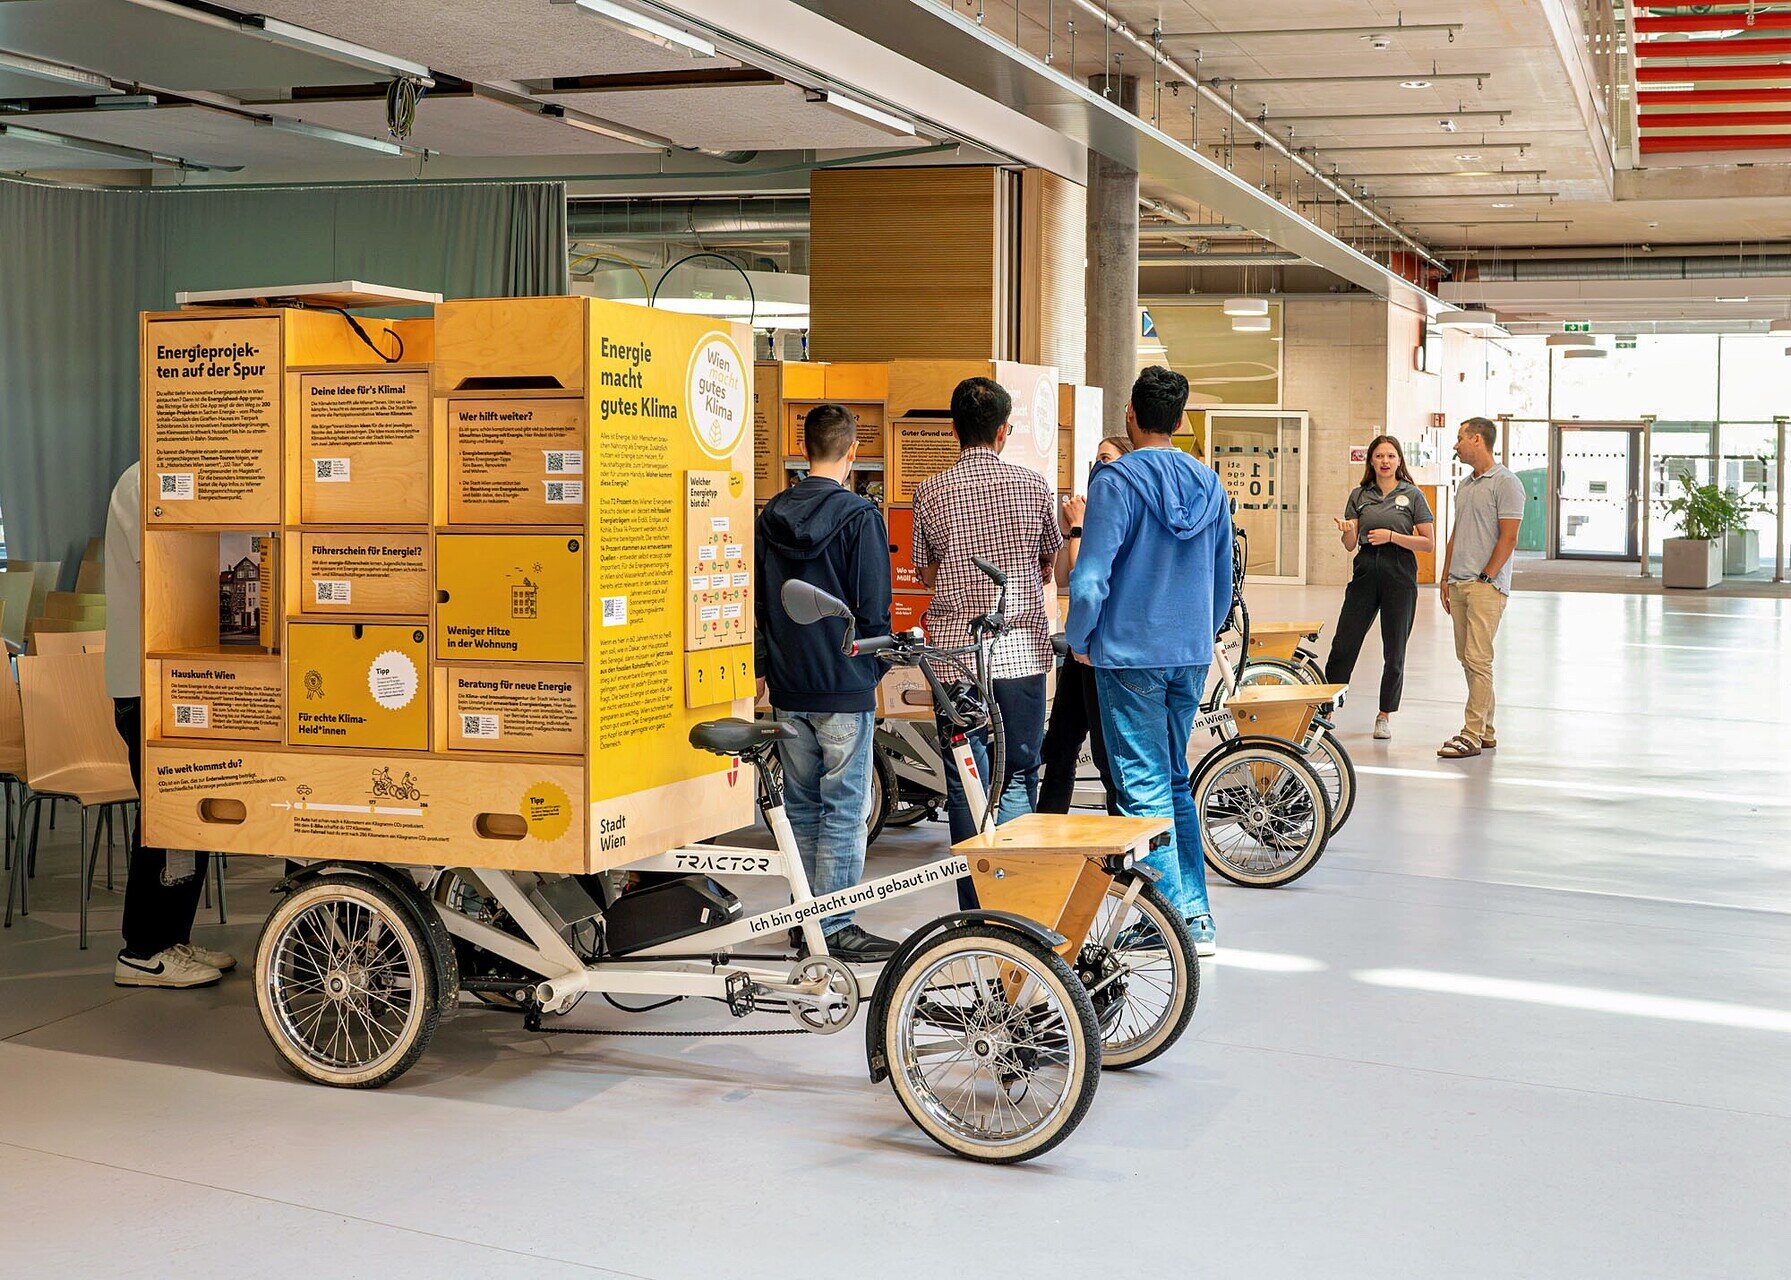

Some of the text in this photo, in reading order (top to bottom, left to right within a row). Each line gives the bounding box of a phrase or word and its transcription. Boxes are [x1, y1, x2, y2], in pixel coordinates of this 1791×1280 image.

[157, 342, 260, 362] Energieprojek-
[601, 337, 652, 367] Energie
[708, 348, 730, 372] Wien
[157, 362, 266, 380] ten auf der Spur
[601, 368, 642, 388] macht
[710, 367, 738, 390] macht
[312, 384, 406, 396] Deine Idee für's Klima!
[698, 378, 726, 400] gutes
[601, 397, 678, 420] gutes Klima
[706, 396, 732, 422] Klima
[459, 412, 533, 421] Wer hilft weiter?
[690, 477, 711, 486] Welcher
[690, 488, 718, 499] Energietyp
[690, 499, 710, 508] bist du?
[312, 546, 422, 558] Führerschein für Energie!?
[448, 626, 510, 638] Weniger Hitze
[448, 638, 518, 651] in der Wohnung
[172, 670, 236, 679] Hauskunft Wien
[698, 669, 703, 683] ?
[720, 666, 725, 680] ?
[742, 662, 746, 676] ?
[459, 679, 572, 693] Beratung für neue Energie
[299, 713, 367, 724] Für echte Klima-
[1195, 713, 1232, 729] in Wien.
[1078, 755, 1092, 764] Ich
[157, 759, 242, 776] Wie weit kommst du?
[600, 814, 626, 834] Stadt
[600, 834, 626, 852] Wien
[676, 854, 770, 872] TRACTOR
[749, 861, 968, 933] Ich bin gedacht und gebaut in Wie
